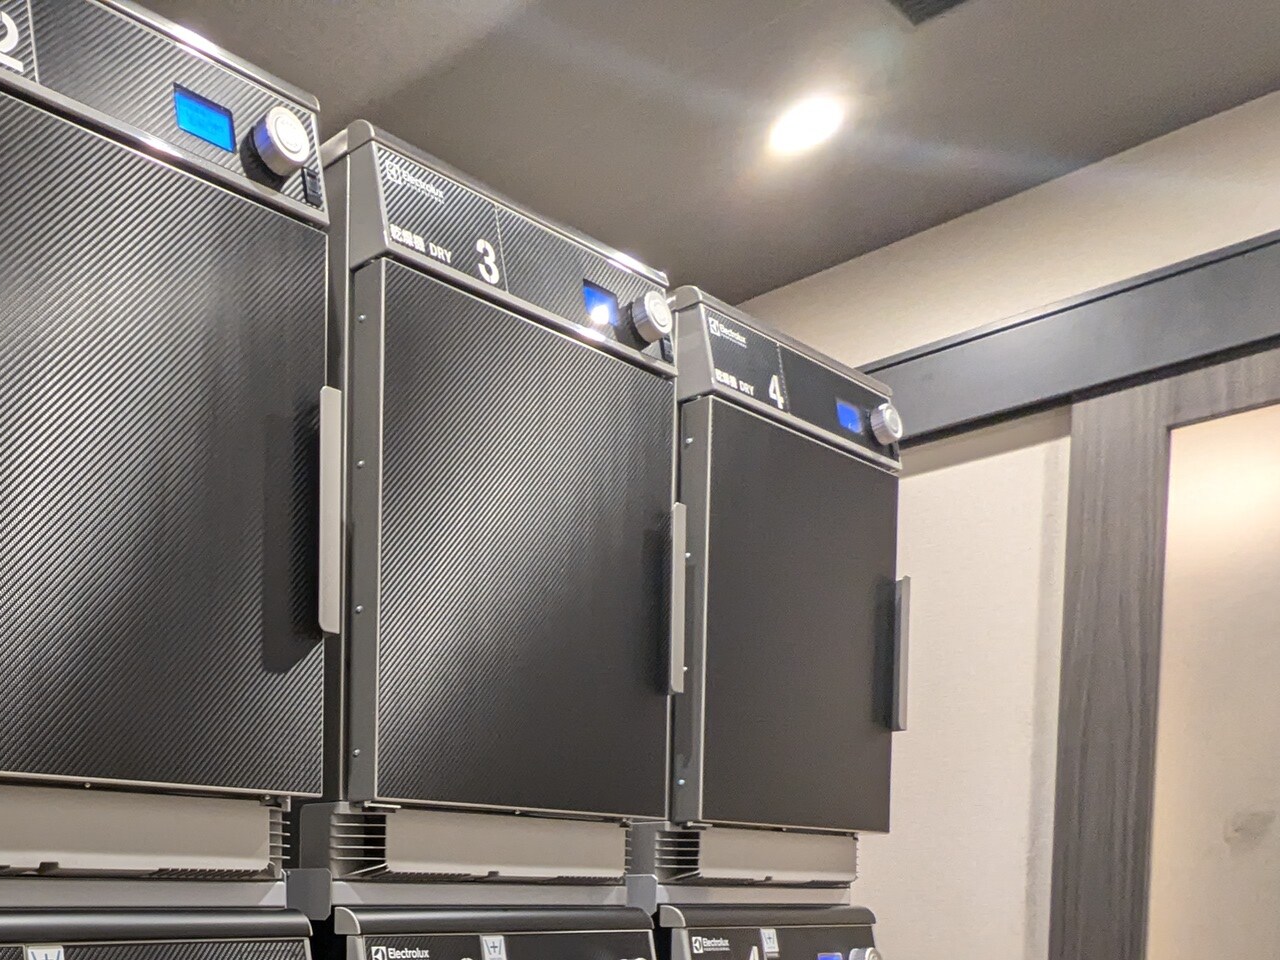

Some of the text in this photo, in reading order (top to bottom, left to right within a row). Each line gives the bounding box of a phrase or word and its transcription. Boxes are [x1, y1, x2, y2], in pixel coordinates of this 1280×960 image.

[429, 242, 452, 263] DRY
[476, 238, 500, 284] 3
[768, 374, 784, 410] 4
[387, 947, 430, 959] Electrolux
